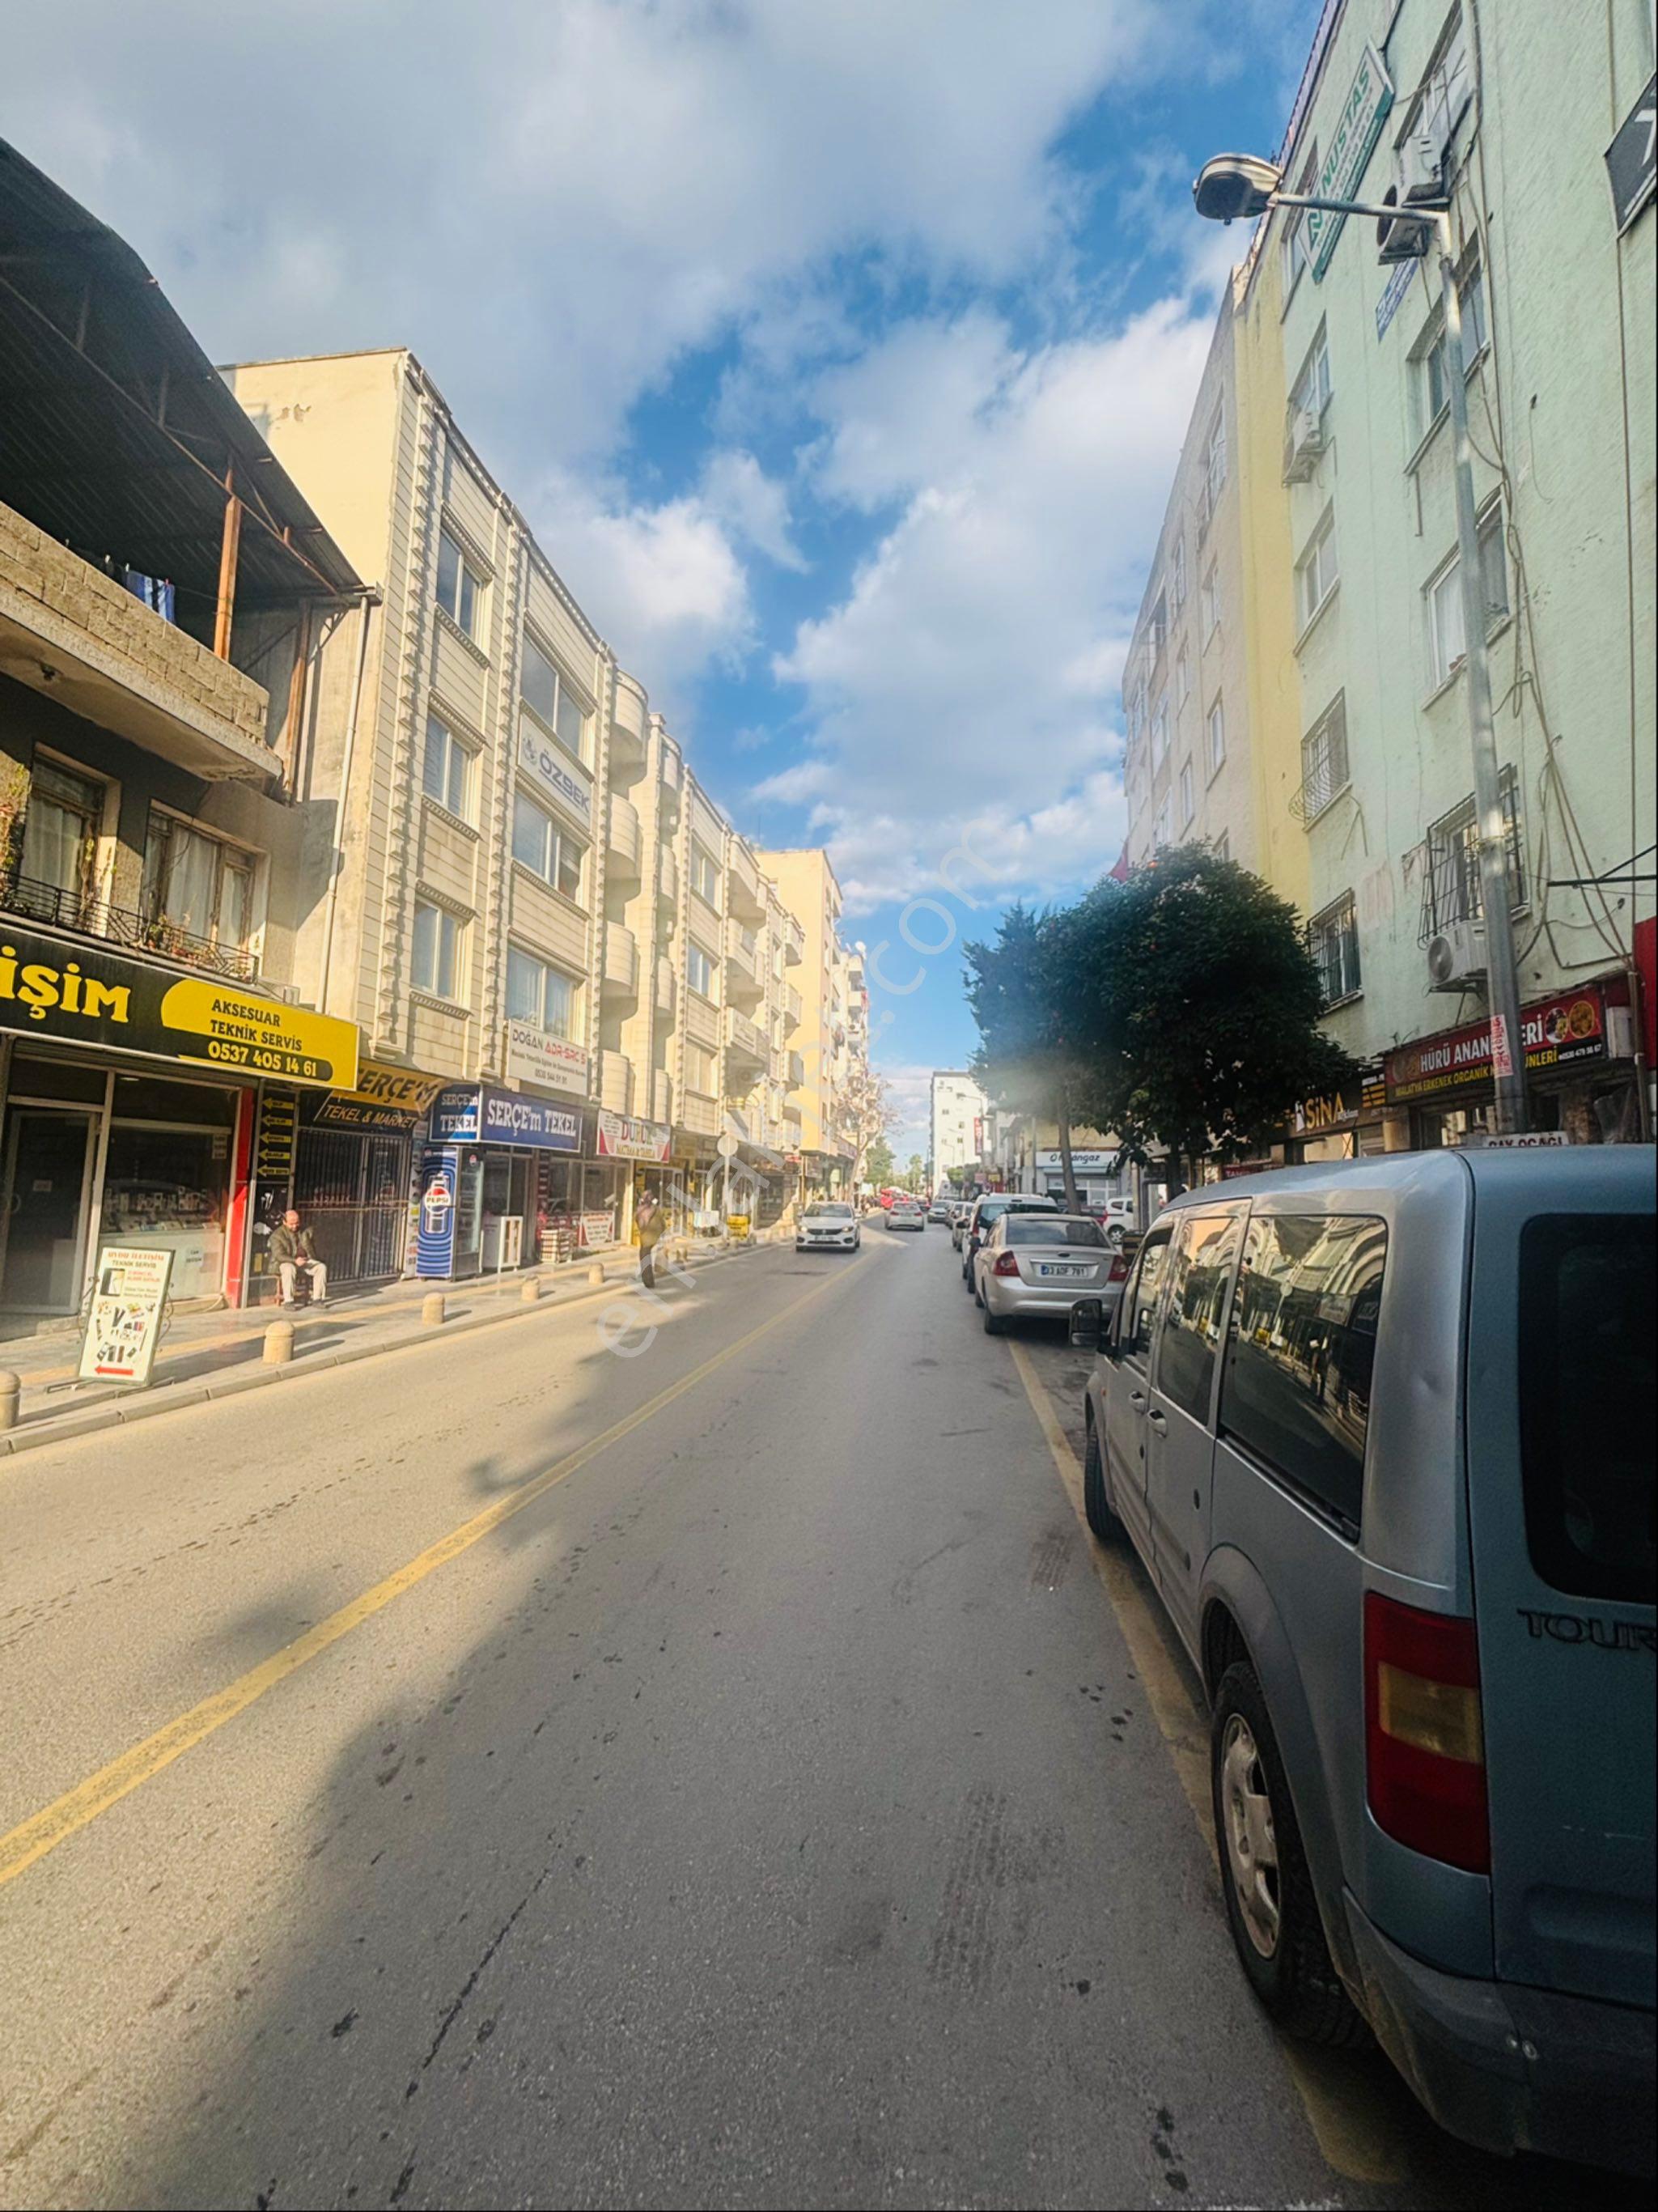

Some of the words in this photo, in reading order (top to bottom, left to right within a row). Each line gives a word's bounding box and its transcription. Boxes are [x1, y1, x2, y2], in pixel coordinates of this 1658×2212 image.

[539, 749, 589, 813] ÖZBEK
[211, 999, 281, 1027] AKSESUAR
[210, 1020, 257, 1042] TEKNİK
[261, 1031, 303, 1051] SERVİS
[512, 1029, 544, 1051] DOĞAN
[208, 1041, 248, 1063] 0537
[252, 1051, 282, 1072] 405
[286, 1056, 299, 1073] 14
[303, 1060, 316, 1076] 61
[1420, 1041, 1451, 1072] HÜRÜ
[1454, 1034, 1490, 1064] ANAN
[1453, 1063, 1489, 1085] ORGANİK
[324, 1103, 362, 1123] TEKEL
[362, 1110, 372, 1123] &
[372, 1111, 418, 1128] MARKET
[440, 1114, 478, 1132] TEKEL
[487, 1098, 541, 1136] SERÇE'm
[544, 1109, 577, 1137] TEKEL
